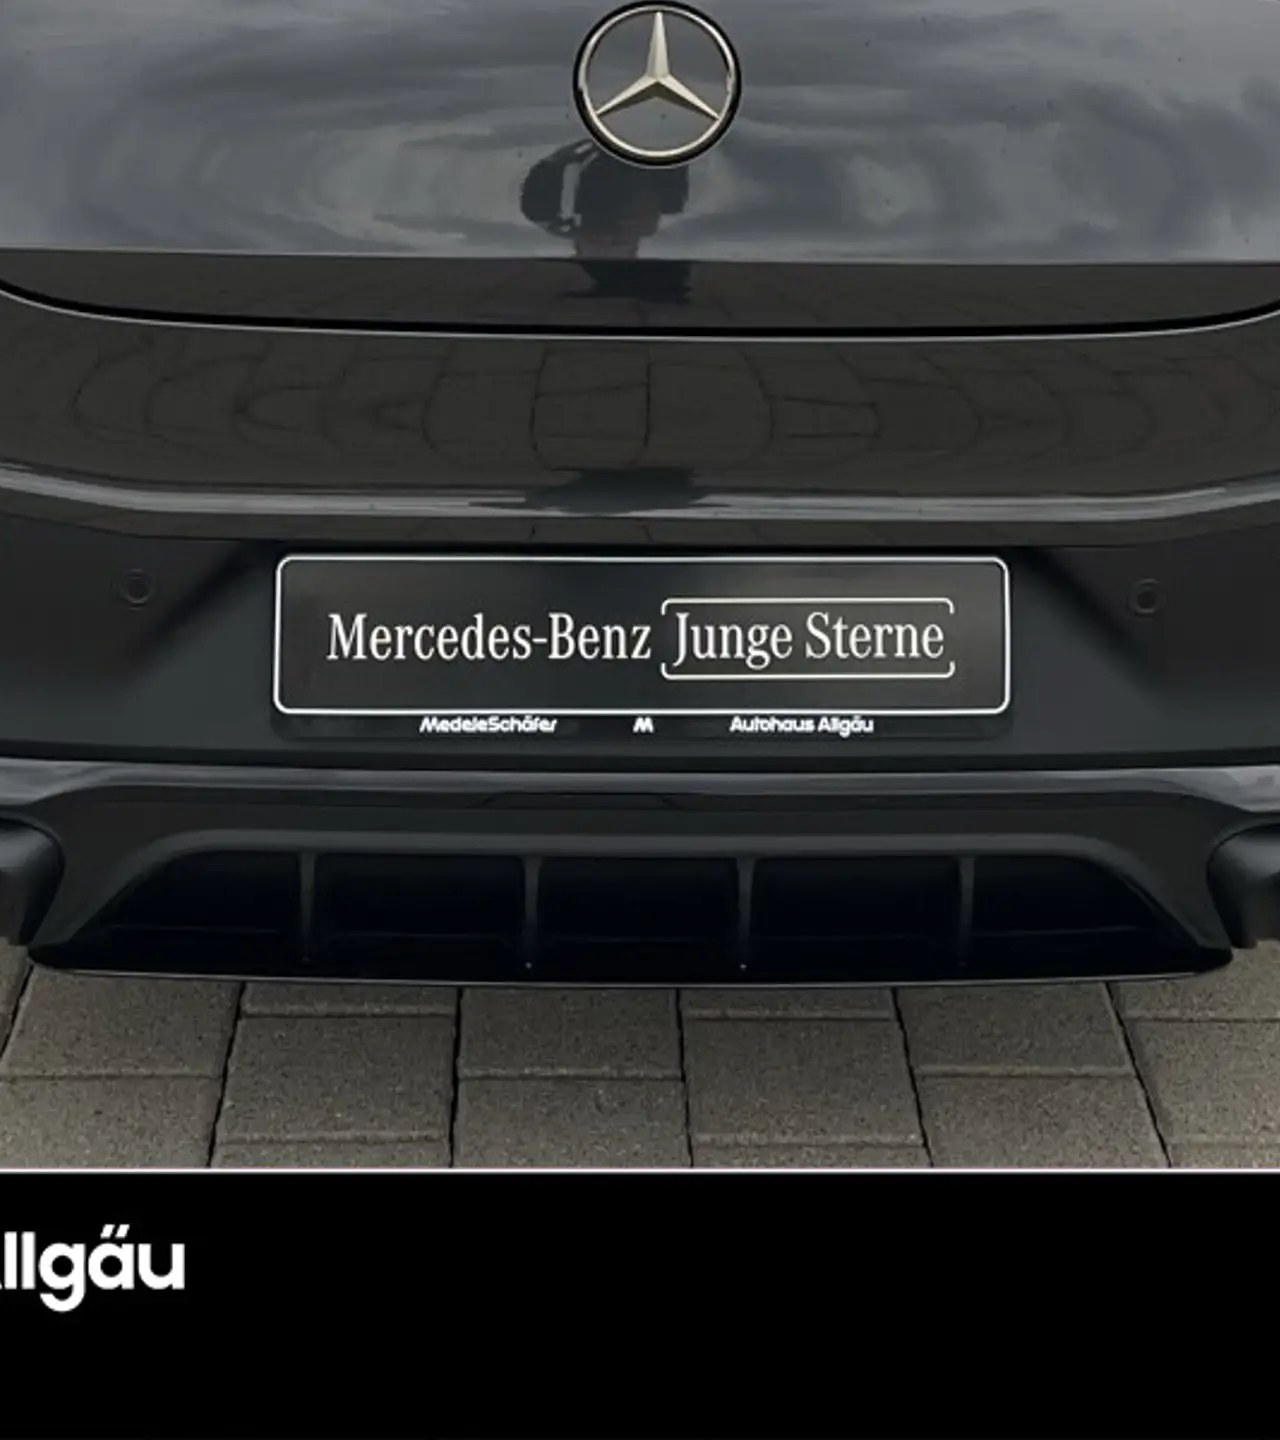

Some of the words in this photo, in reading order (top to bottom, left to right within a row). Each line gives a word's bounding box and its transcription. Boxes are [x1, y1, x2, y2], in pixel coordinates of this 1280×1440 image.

[327, 613, 651, 660] Mercedes-Benz
[673, 612, 792, 670] Junge
[805, 611, 945, 660] Sterne
[420, 715, 557, 732] MedeleSchäfer
[730, 716, 813, 732] Autohaus
[818, 715, 874, 737] Allgäu
